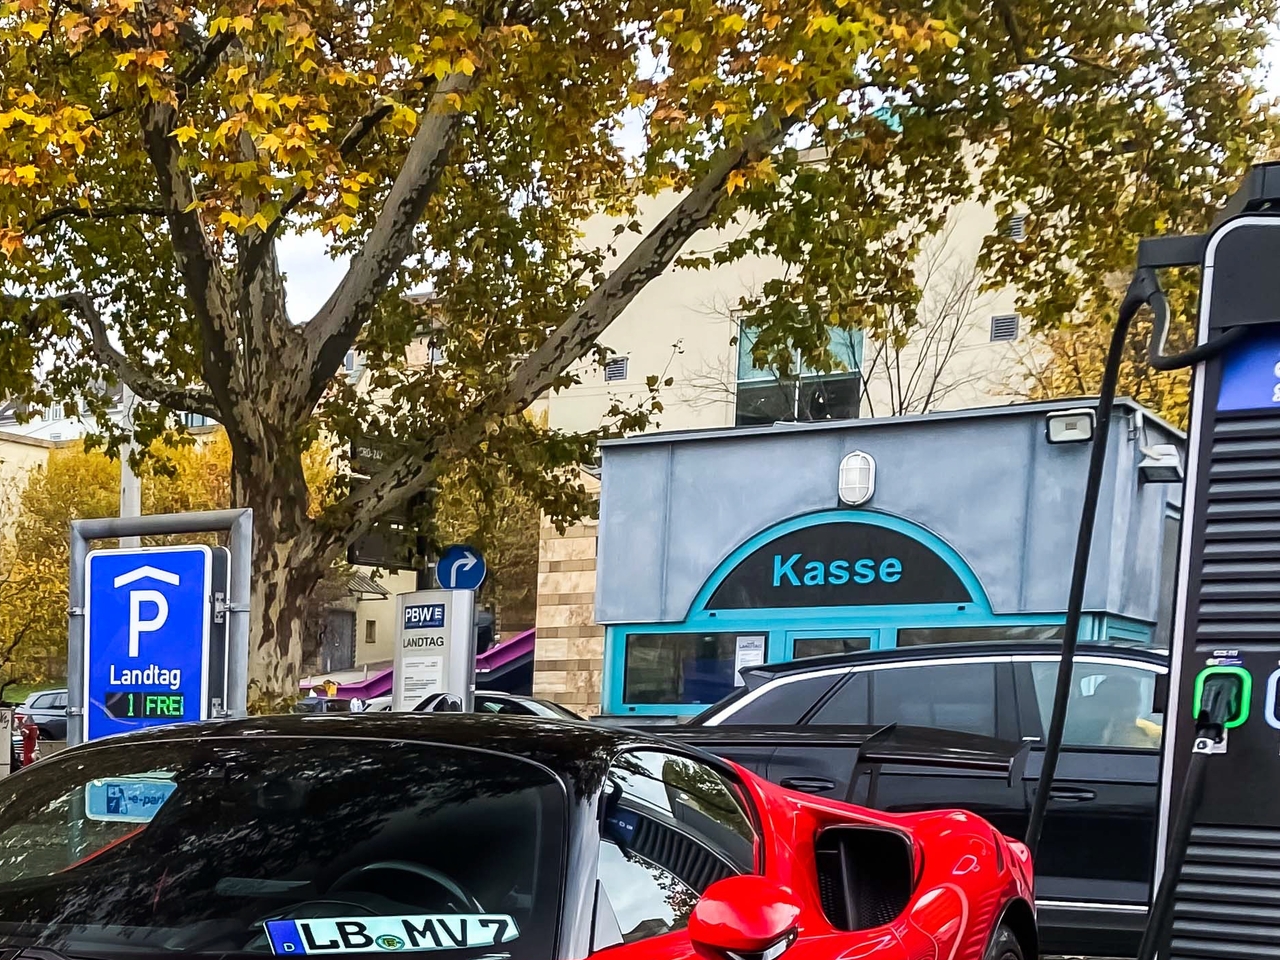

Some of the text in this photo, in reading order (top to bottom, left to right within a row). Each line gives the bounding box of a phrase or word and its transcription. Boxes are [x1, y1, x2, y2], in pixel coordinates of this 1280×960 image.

[773, 553, 903, 587] Kasse
[128, 590, 169, 658] P
[405, 607, 433, 626] PBW
[403, 637, 444, 648] LANDTAG
[110, 665, 181, 690] Landtag
[146, 696, 184, 716] FREI
[283, 918, 510, 952] D LB MV 7
